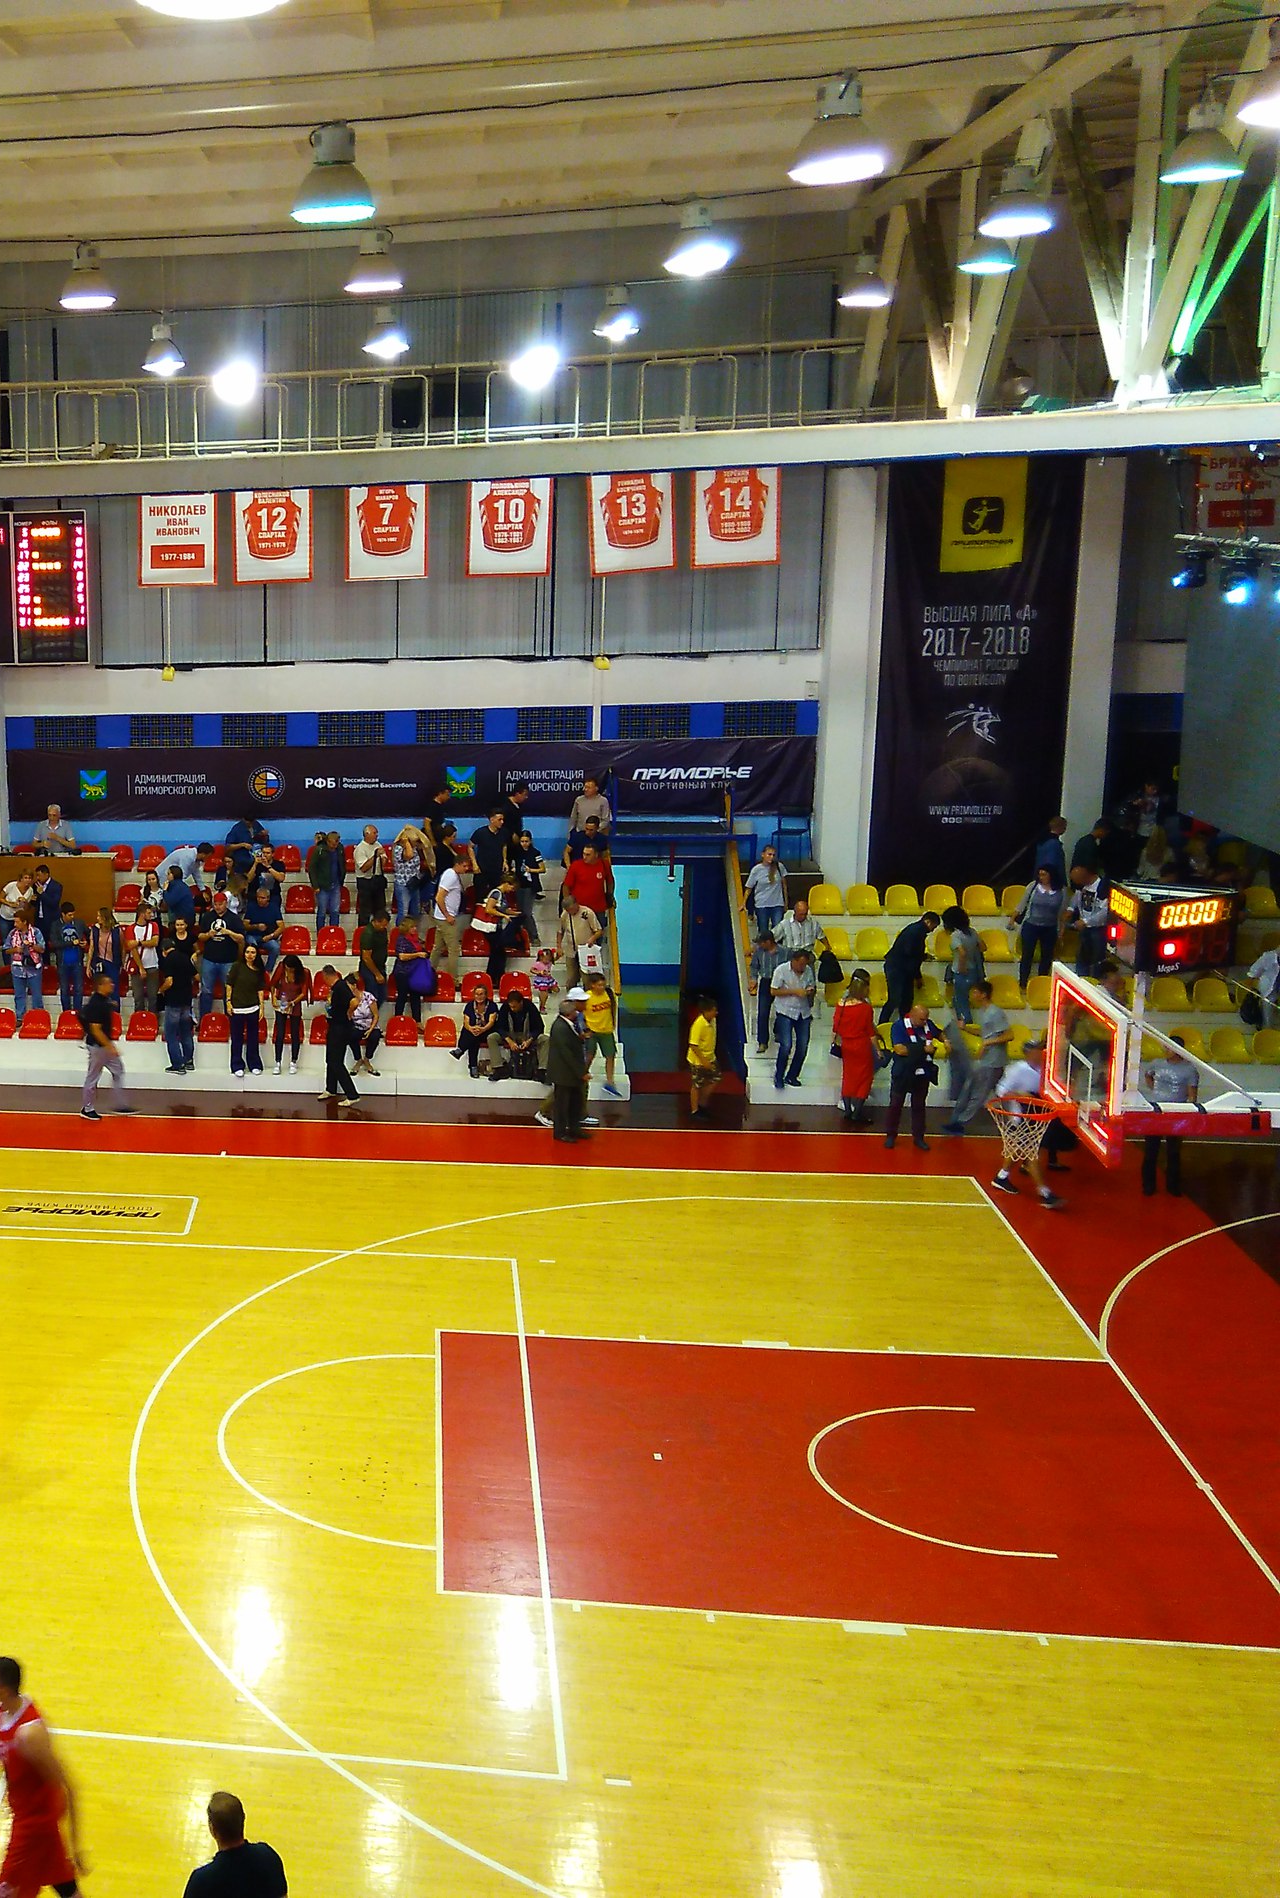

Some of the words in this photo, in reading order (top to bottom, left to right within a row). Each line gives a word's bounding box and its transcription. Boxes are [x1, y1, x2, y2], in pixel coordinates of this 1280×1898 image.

[719, 486, 752, 512] 14
[149, 504, 207, 517] НИКОЛАЕВ
[493, 498, 525, 523] 10
[616, 493, 647, 518] 13
[257, 507, 287, 531] 12
[379, 503, 393, 525] 7
[720, 511, 751, 519] СПАРТАК
[166, 518, 189, 526] ИВАН
[618, 517, 646, 526] СПАРТАК
[156, 527, 200, 536] ИВАНОВИЧ
[160, 552, 196, 561] 1977-1984
[924, 606, 977, 623] ВЫСШАЯ
[981, 605, 1011, 622] ЛИГА
[921, 626, 1031, 657] 2017-2018
[933, 660, 983, 672] ЧЕМПИОНАТ
[985, 659, 1020, 671] РОССИИ
[944, 675, 956, 686] ПО
[958, 674, 1007, 686] ВОЛЕЙБОЛУ
[134, 774, 207, 785] АДМИНИСТРАЦИЯ
[506, 769, 584, 781] АДМИНИСТРАЦИЯ
[632, 766, 753, 781] ПРИМОРЬЕ
[305, 777, 336, 789] РФБ
[640, 781, 707, 791] СПОРТИВНЫЙ
[134, 785, 193, 796] ПРИМОРСКОГО
[195, 785, 217, 796] КРАЯ
[1157, 962, 1180, 973] MegaS
[2, 1206, 161, 1219] ПРИМОРЬЕ
